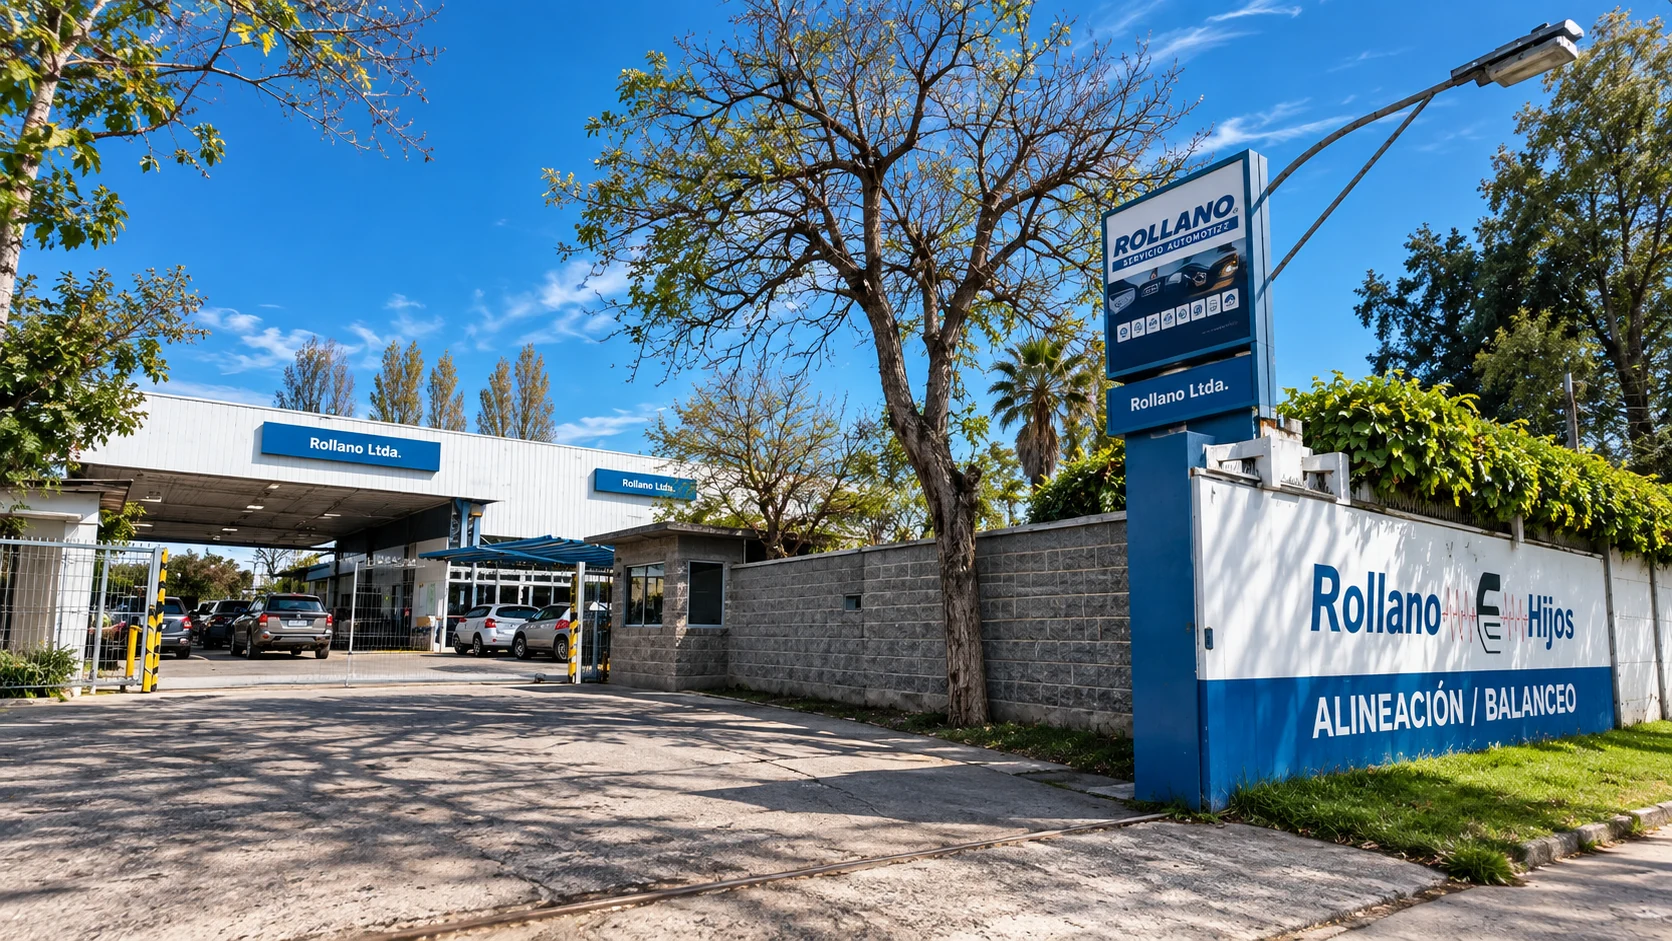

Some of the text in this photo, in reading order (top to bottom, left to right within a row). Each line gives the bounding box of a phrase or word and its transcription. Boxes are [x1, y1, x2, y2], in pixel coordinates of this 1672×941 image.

[1113, 194, 1235, 258] ROLLANO
[1130, 378, 1229, 411] Rollano Ltda.
[309, 437, 402, 458] Rollano Ltda.
[622, 478, 653, 490] Rollano
[1310, 563, 1441, 636] Rollano
[1528, 594, 1574, 651] Hijos
[1312, 679, 1464, 739] ALINEACIÓN
[1485, 682, 1577, 722] BALANCEO
